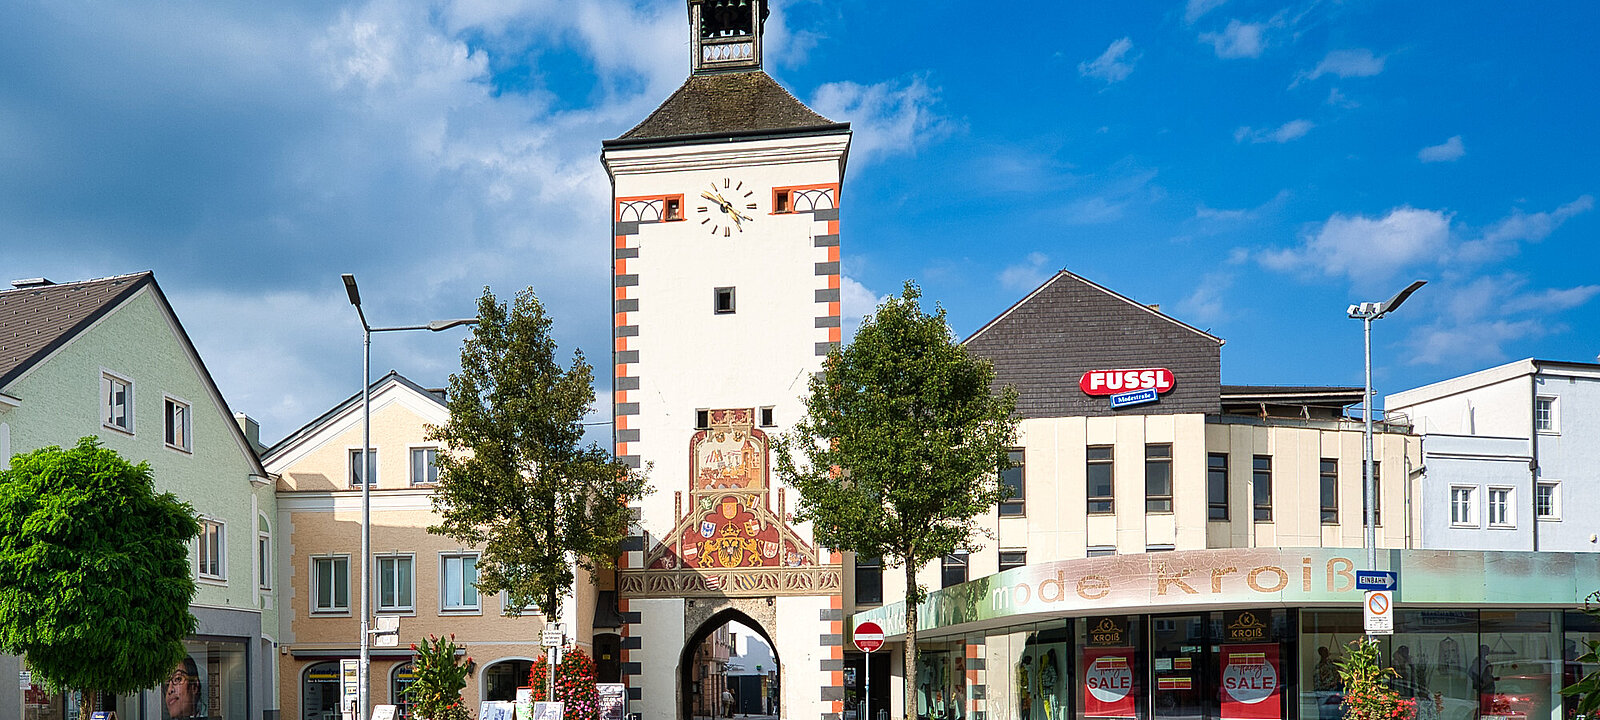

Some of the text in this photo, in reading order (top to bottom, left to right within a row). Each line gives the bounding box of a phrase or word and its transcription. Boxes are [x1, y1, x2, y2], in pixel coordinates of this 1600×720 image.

[1090, 370, 1170, 390] FUSSL
[992, 557, 1356, 611] mode kroiß
[1360, 576, 1387, 584] EINBAHN
[1243, 615, 1250, 624] K
[1088, 677, 1130, 690] SALE
[1226, 676, 1274, 690] SALE
